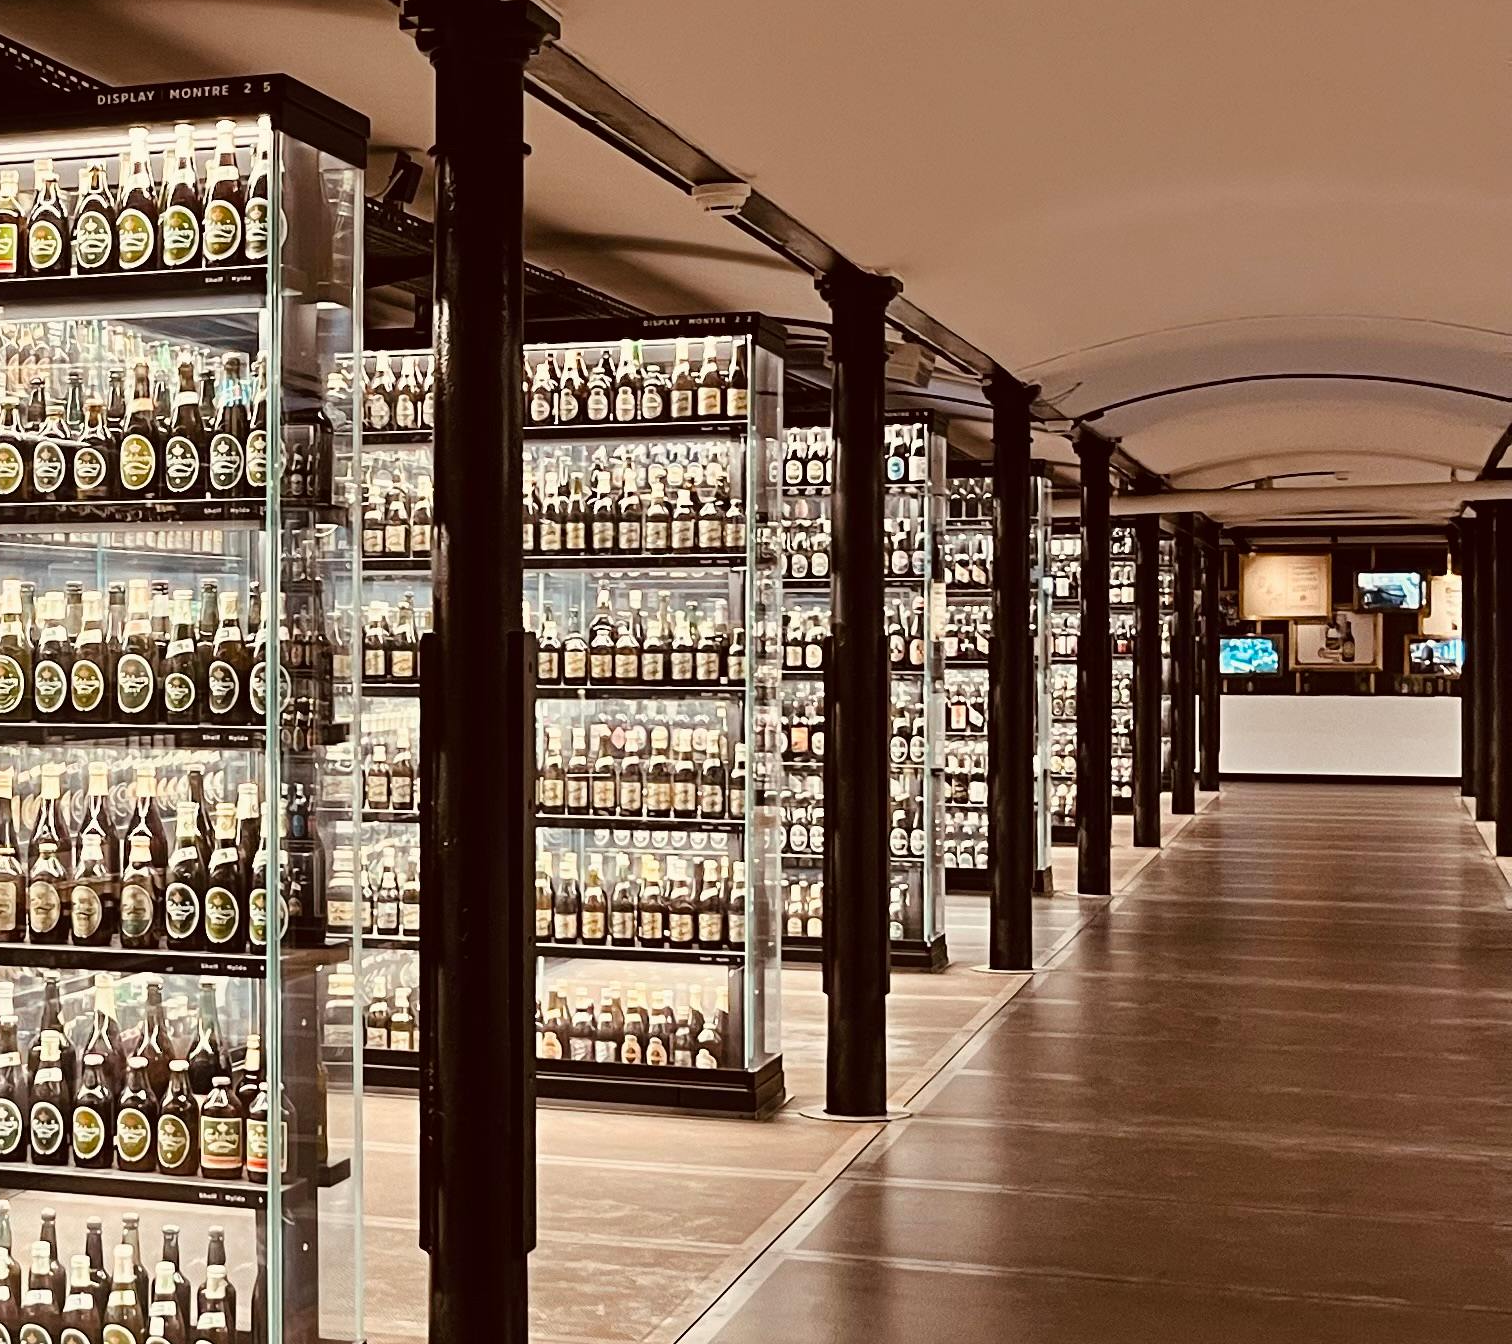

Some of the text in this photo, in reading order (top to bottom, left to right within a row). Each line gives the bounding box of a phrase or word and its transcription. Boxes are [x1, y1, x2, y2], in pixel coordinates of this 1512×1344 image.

[96, 90, 155, 106] DISPLAY
[168, 84, 230, 100] MONTRE
[642, 318, 680, 327] DISPLAY
[688, 316, 726, 325] MONTRE
